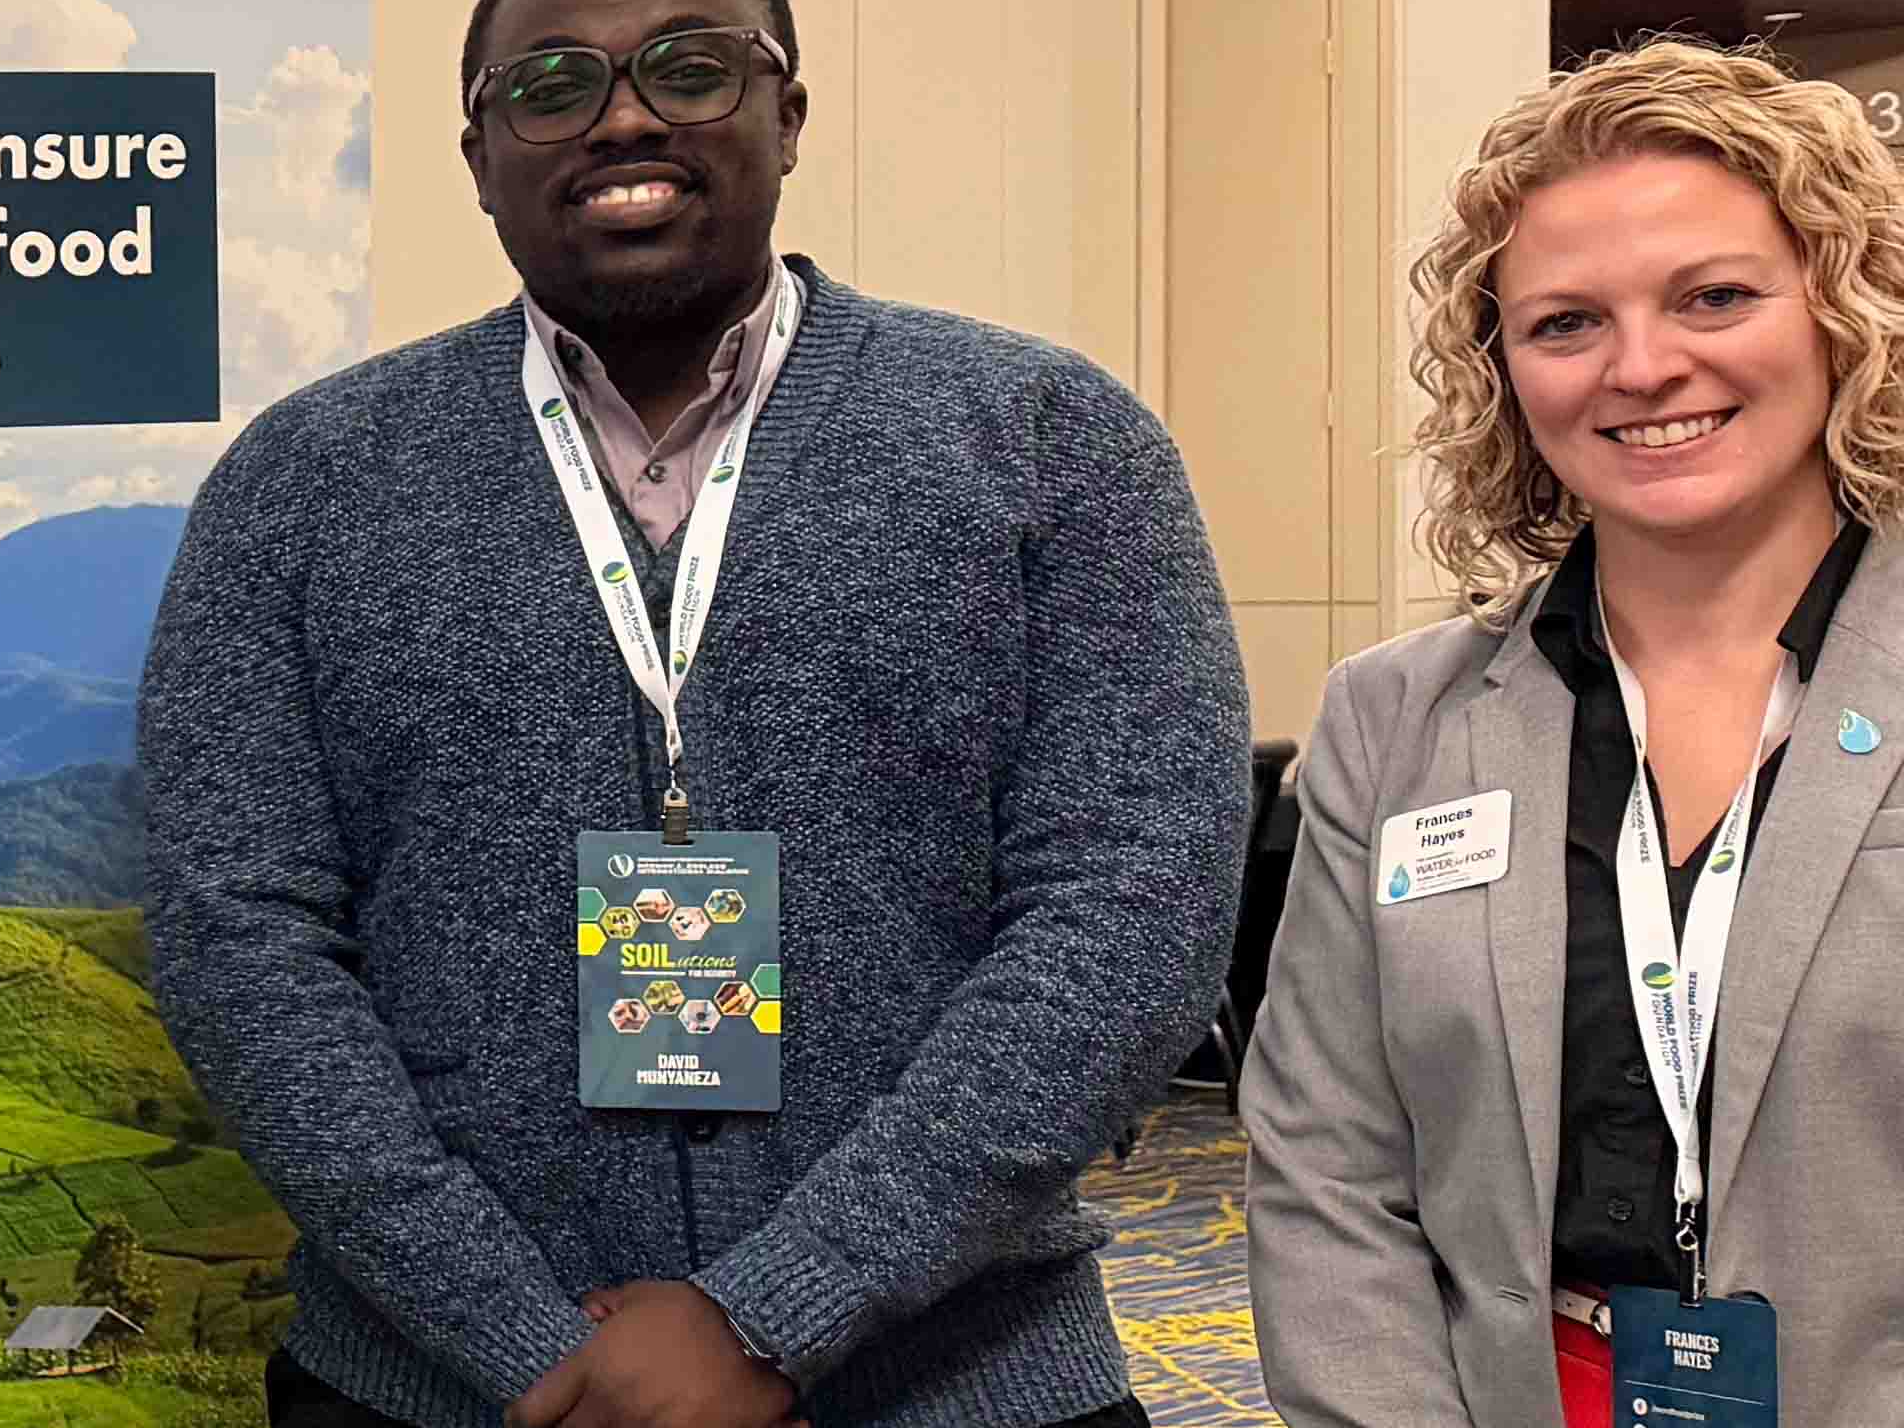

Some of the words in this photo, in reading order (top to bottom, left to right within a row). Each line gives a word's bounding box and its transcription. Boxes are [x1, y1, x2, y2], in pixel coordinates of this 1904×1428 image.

[1416, 808, 1472, 830] Frances
[1421, 828, 1465, 848] Hayes
[1663, 992, 1676, 1036] WORLD
[1670, 1039, 1682, 1073] FOOD
[658, 1054, 699, 1069] DAVID
[1665, 1329, 1719, 1354] FRANCES
[1674, 1349, 1712, 1370] HAYES
